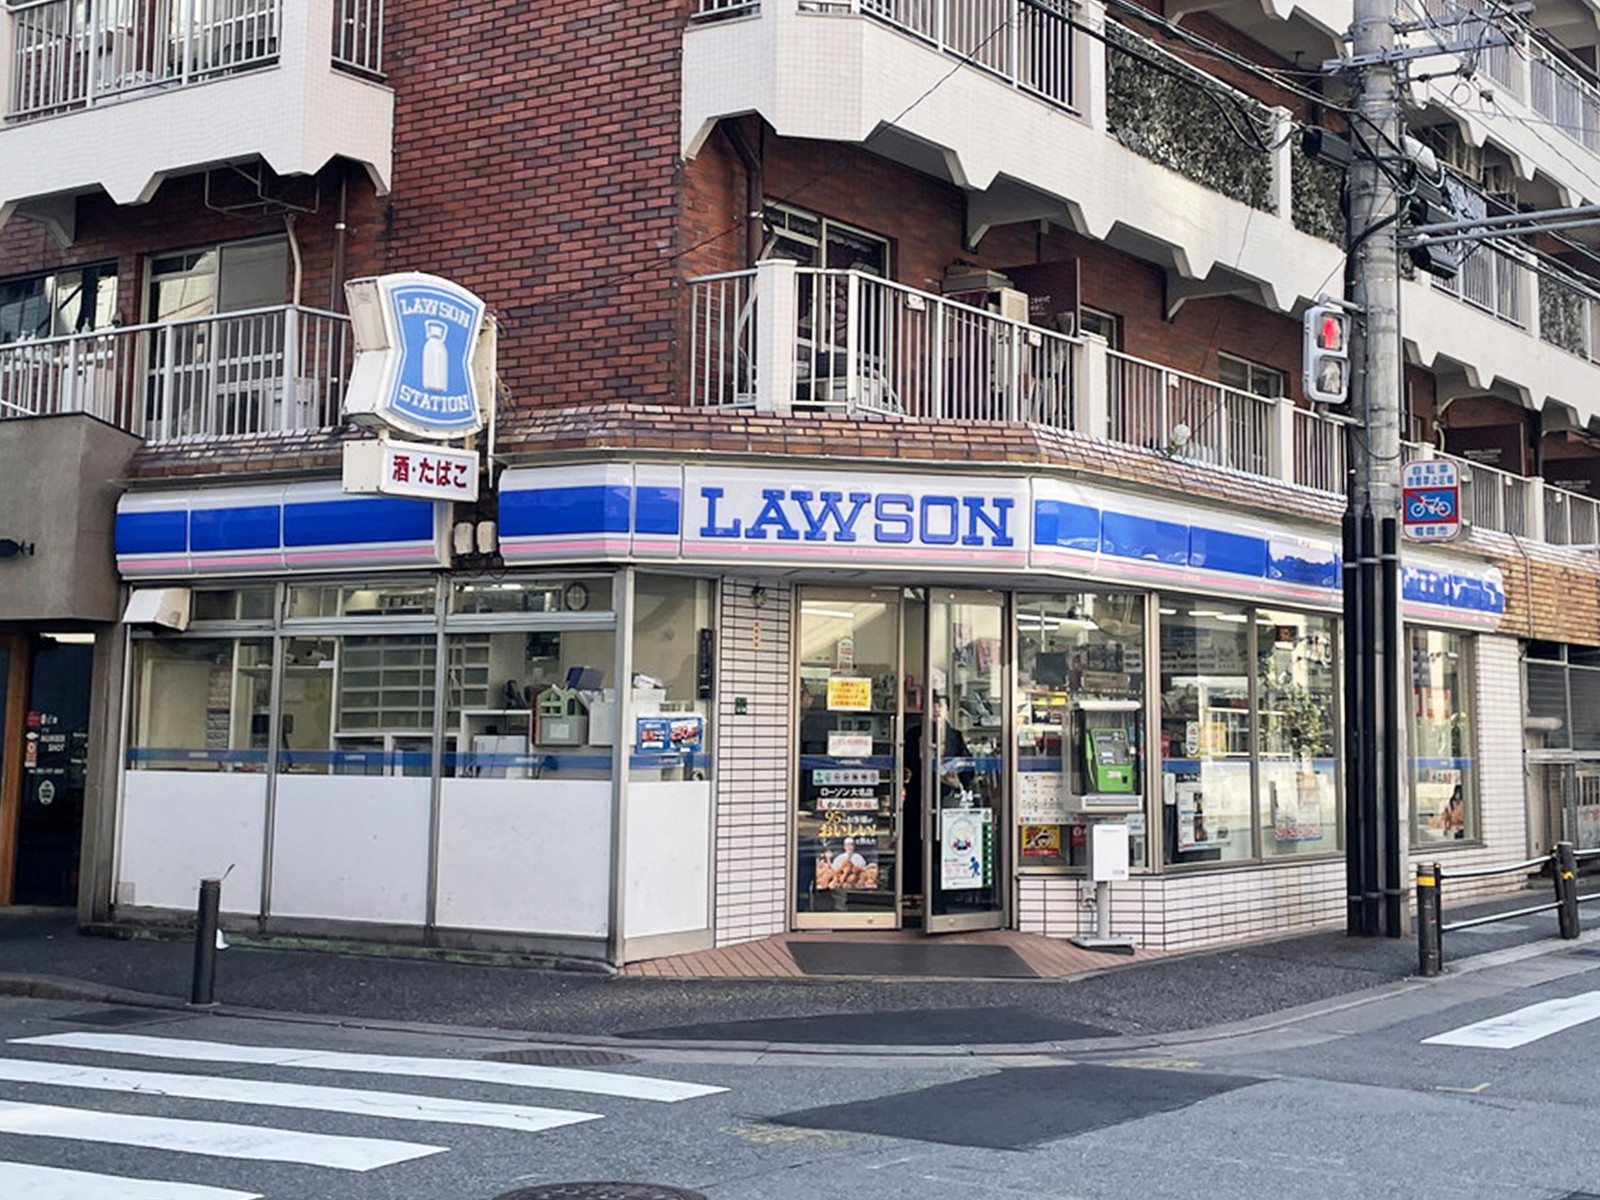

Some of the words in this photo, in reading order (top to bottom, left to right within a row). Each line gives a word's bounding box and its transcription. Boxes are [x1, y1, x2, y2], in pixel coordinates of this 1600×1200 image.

[400, 298, 471, 329] LAWSON
[399, 384, 470, 413] STATION
[392, 455, 468, 489] 酒・たばこ
[1412, 464, 1448, 476] 自転車
[700, 487, 1014, 547] LAWSON
